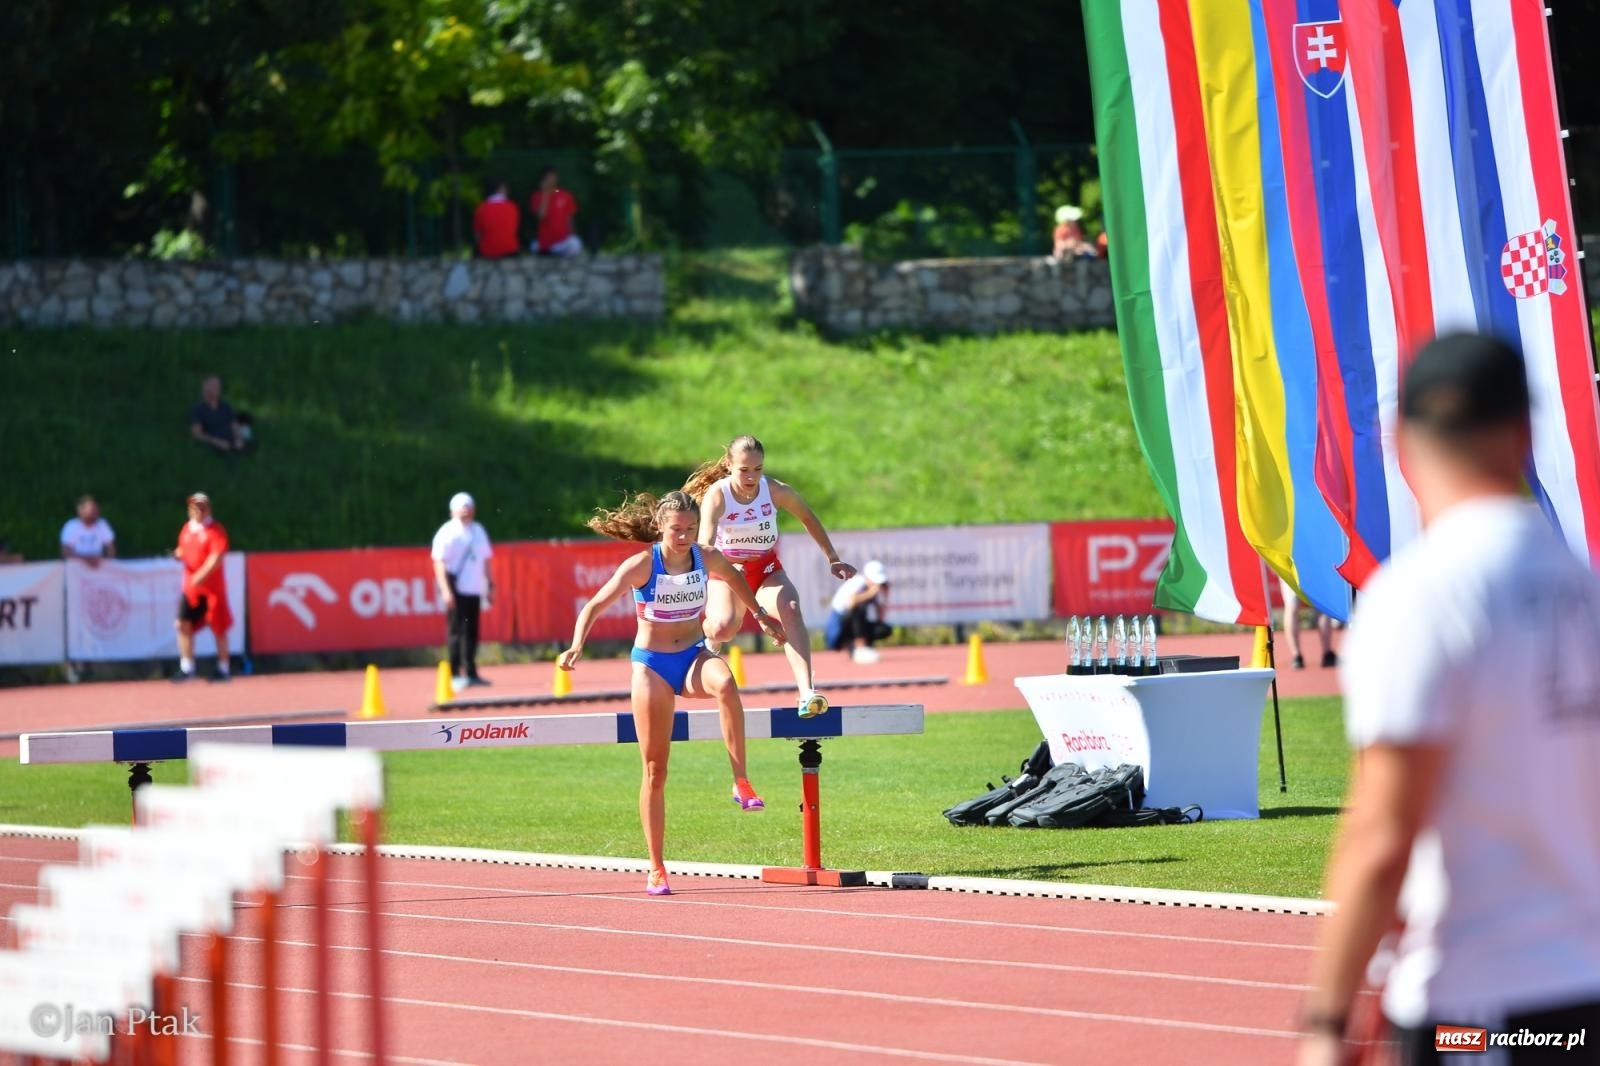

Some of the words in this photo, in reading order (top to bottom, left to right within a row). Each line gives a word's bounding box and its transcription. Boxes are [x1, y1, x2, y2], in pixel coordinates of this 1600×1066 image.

[758, 521, 771, 531] 18
[685, 573, 701, 586] 118
[656, 588, 704, 605] MENŠÍKOVÁ
[459, 722, 530, 744] polanik
